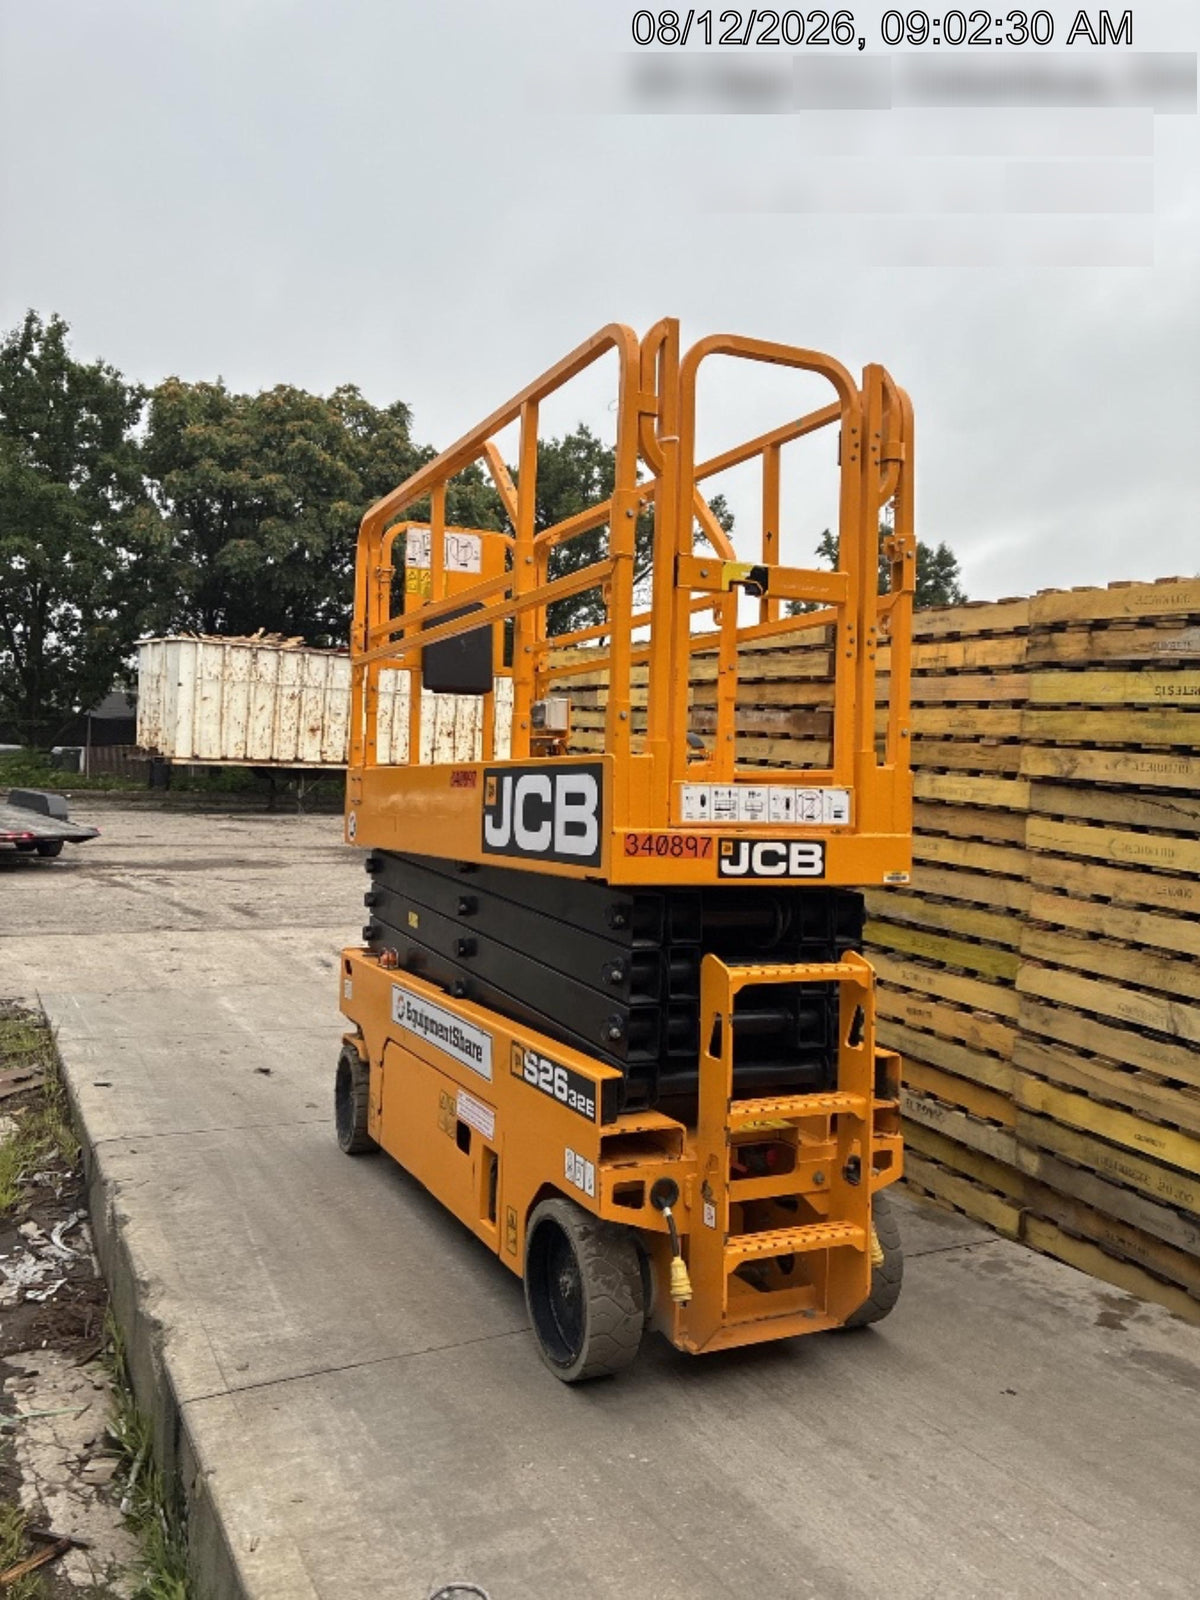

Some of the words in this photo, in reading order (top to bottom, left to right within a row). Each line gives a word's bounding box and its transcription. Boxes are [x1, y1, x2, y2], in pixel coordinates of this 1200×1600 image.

[485, 773, 599, 856] JCB
[625, 833, 712, 857] 340897
[720, 842, 824, 876] JCB
[406, 1000, 483, 1064] EquipmentShare
